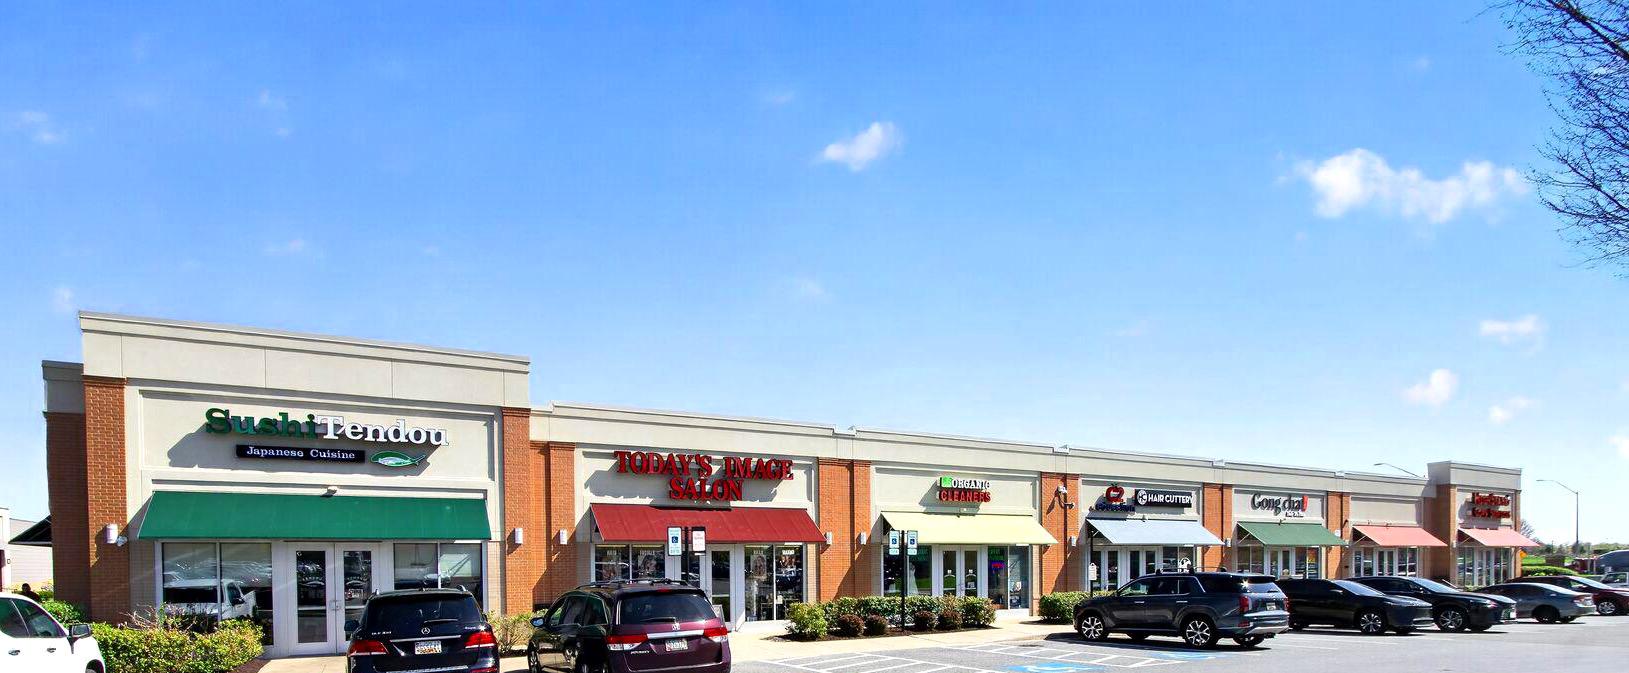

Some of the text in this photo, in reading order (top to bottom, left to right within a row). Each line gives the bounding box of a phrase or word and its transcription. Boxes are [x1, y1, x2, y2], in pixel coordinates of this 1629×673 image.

[246, 446, 356, 459] Japanese Cuisine
[614, 451, 794, 481] TODAY'S IMAGE
[669, 477, 744, 501] SALON
[952, 479, 991, 489] ORGANIC
[940, 490, 991, 502] CLEANERS
[1148, 494, 1194, 504] HAIR CUTTERY
[1251, 493, 1281, 516] Gong
